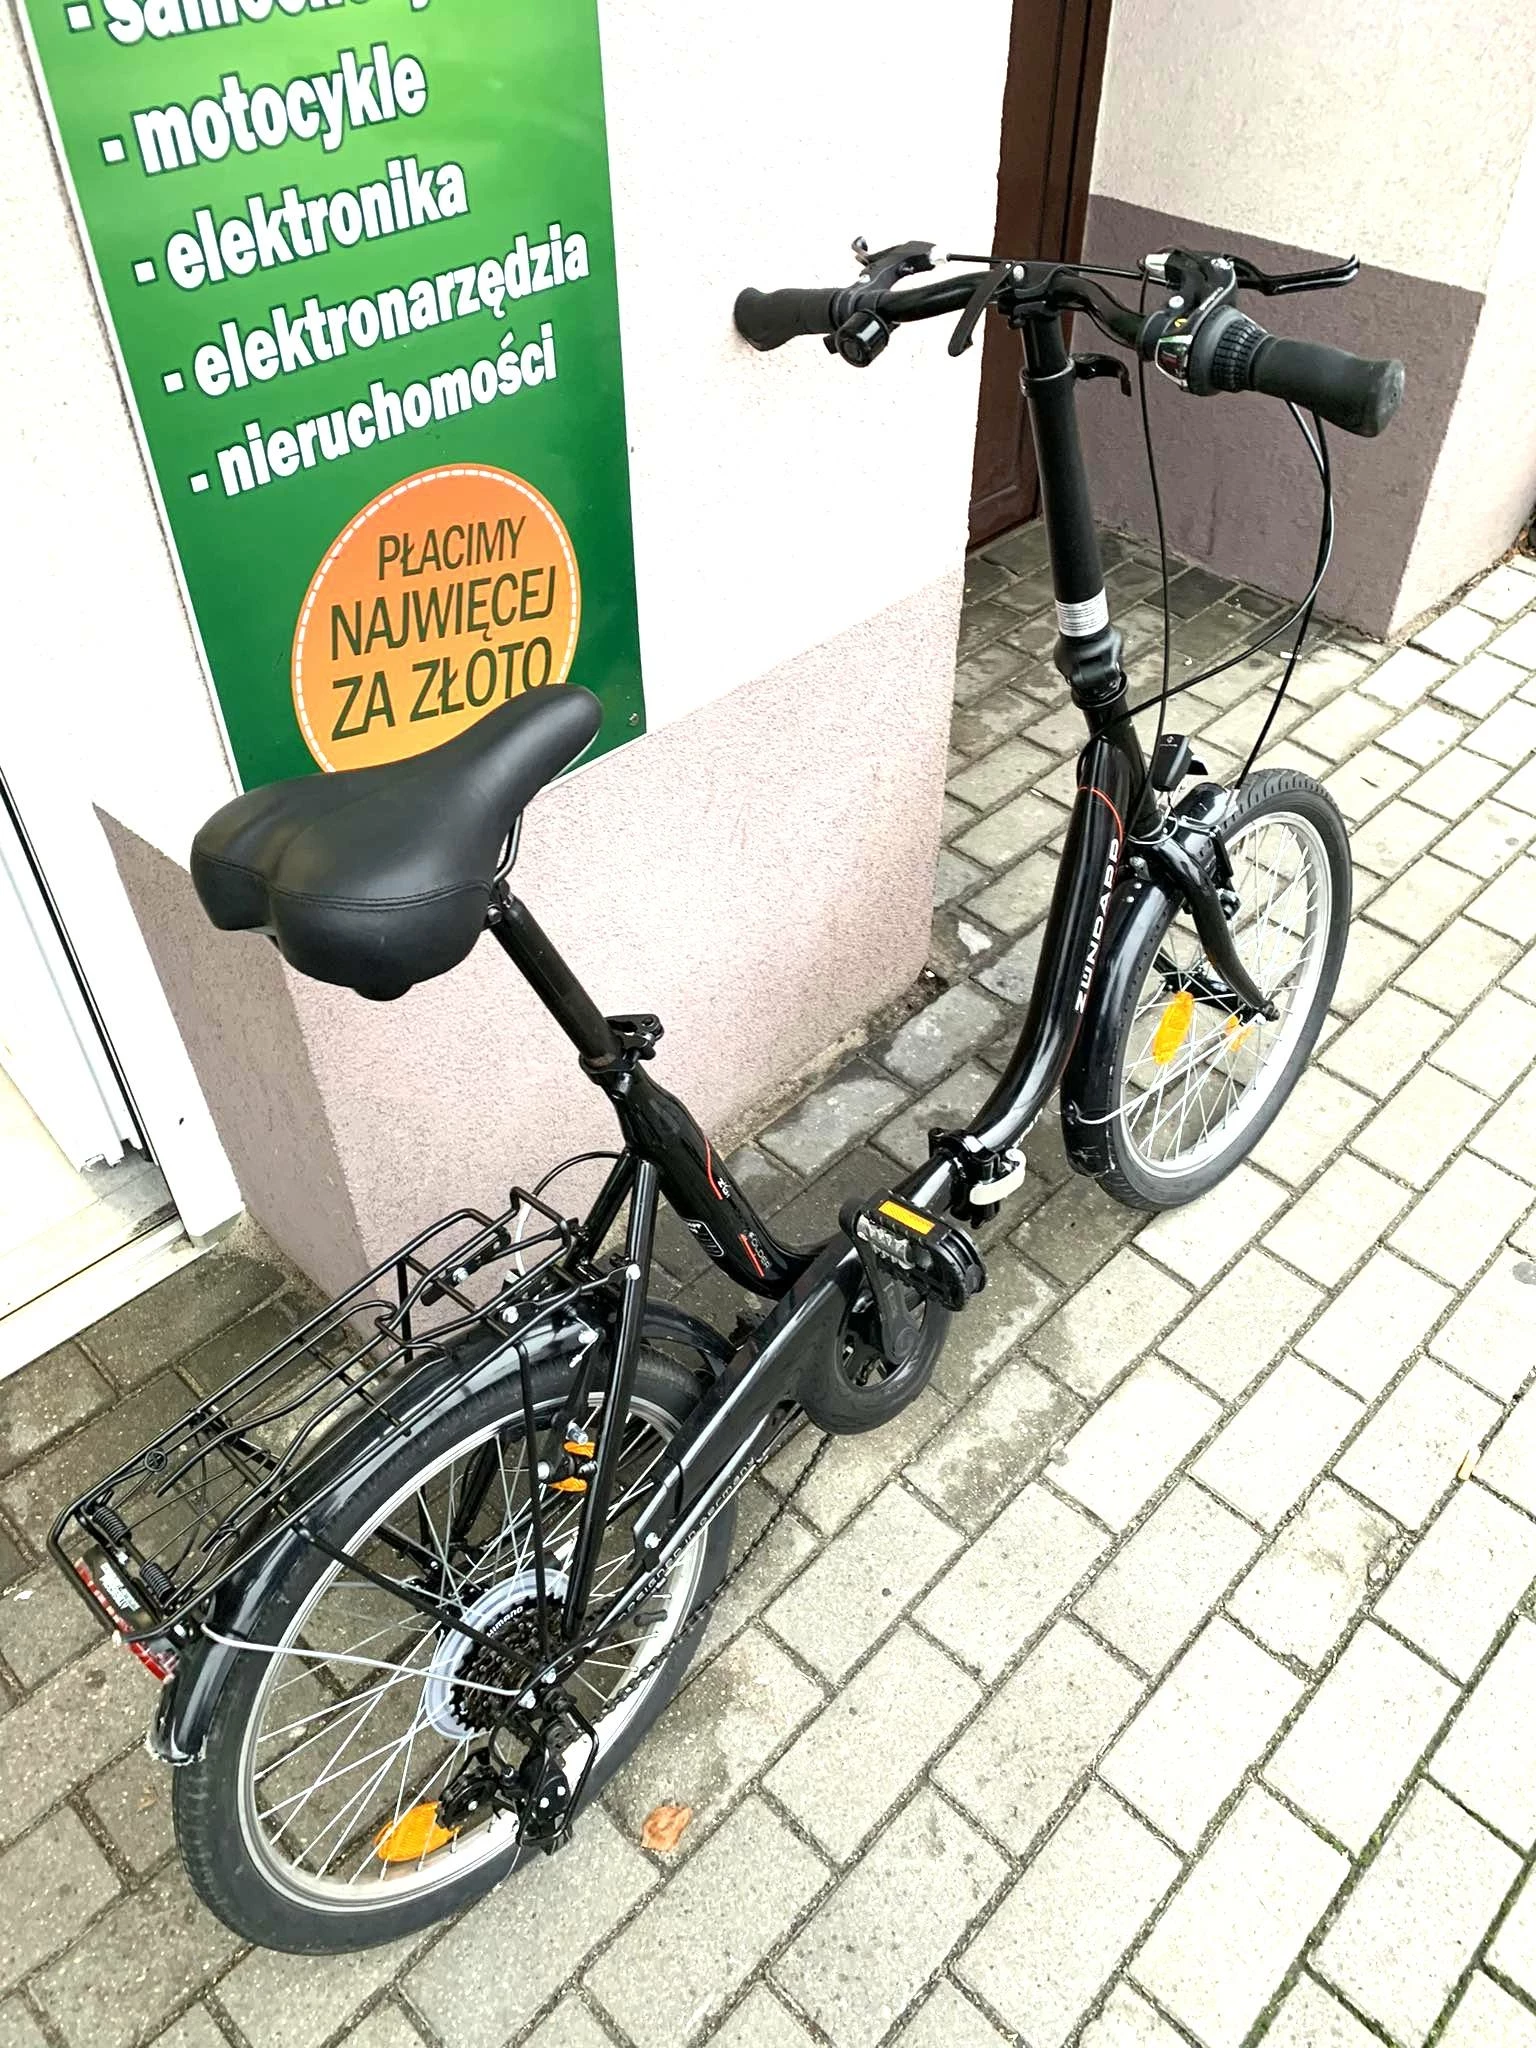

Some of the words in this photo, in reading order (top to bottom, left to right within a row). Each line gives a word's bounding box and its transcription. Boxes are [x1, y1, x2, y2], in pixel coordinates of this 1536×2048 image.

[132, 43, 427, 175] motocykle
[166, 157, 468, 289] elektronika
[194, 223, 590, 397] elektronarzędzia
[217, 322, 557, 496] nieruchomości
[330, 565, 557, 661] NAJWIĘCEJ
[378, 516, 526, 581] PŁACIMY
[331, 670, 396, 741] ZA
[409, 636, 552, 723] ZŁOTO
[1075, 838, 1120, 1014] ZÜNDAPP
[485, 1605, 524, 1639] HIMANO
